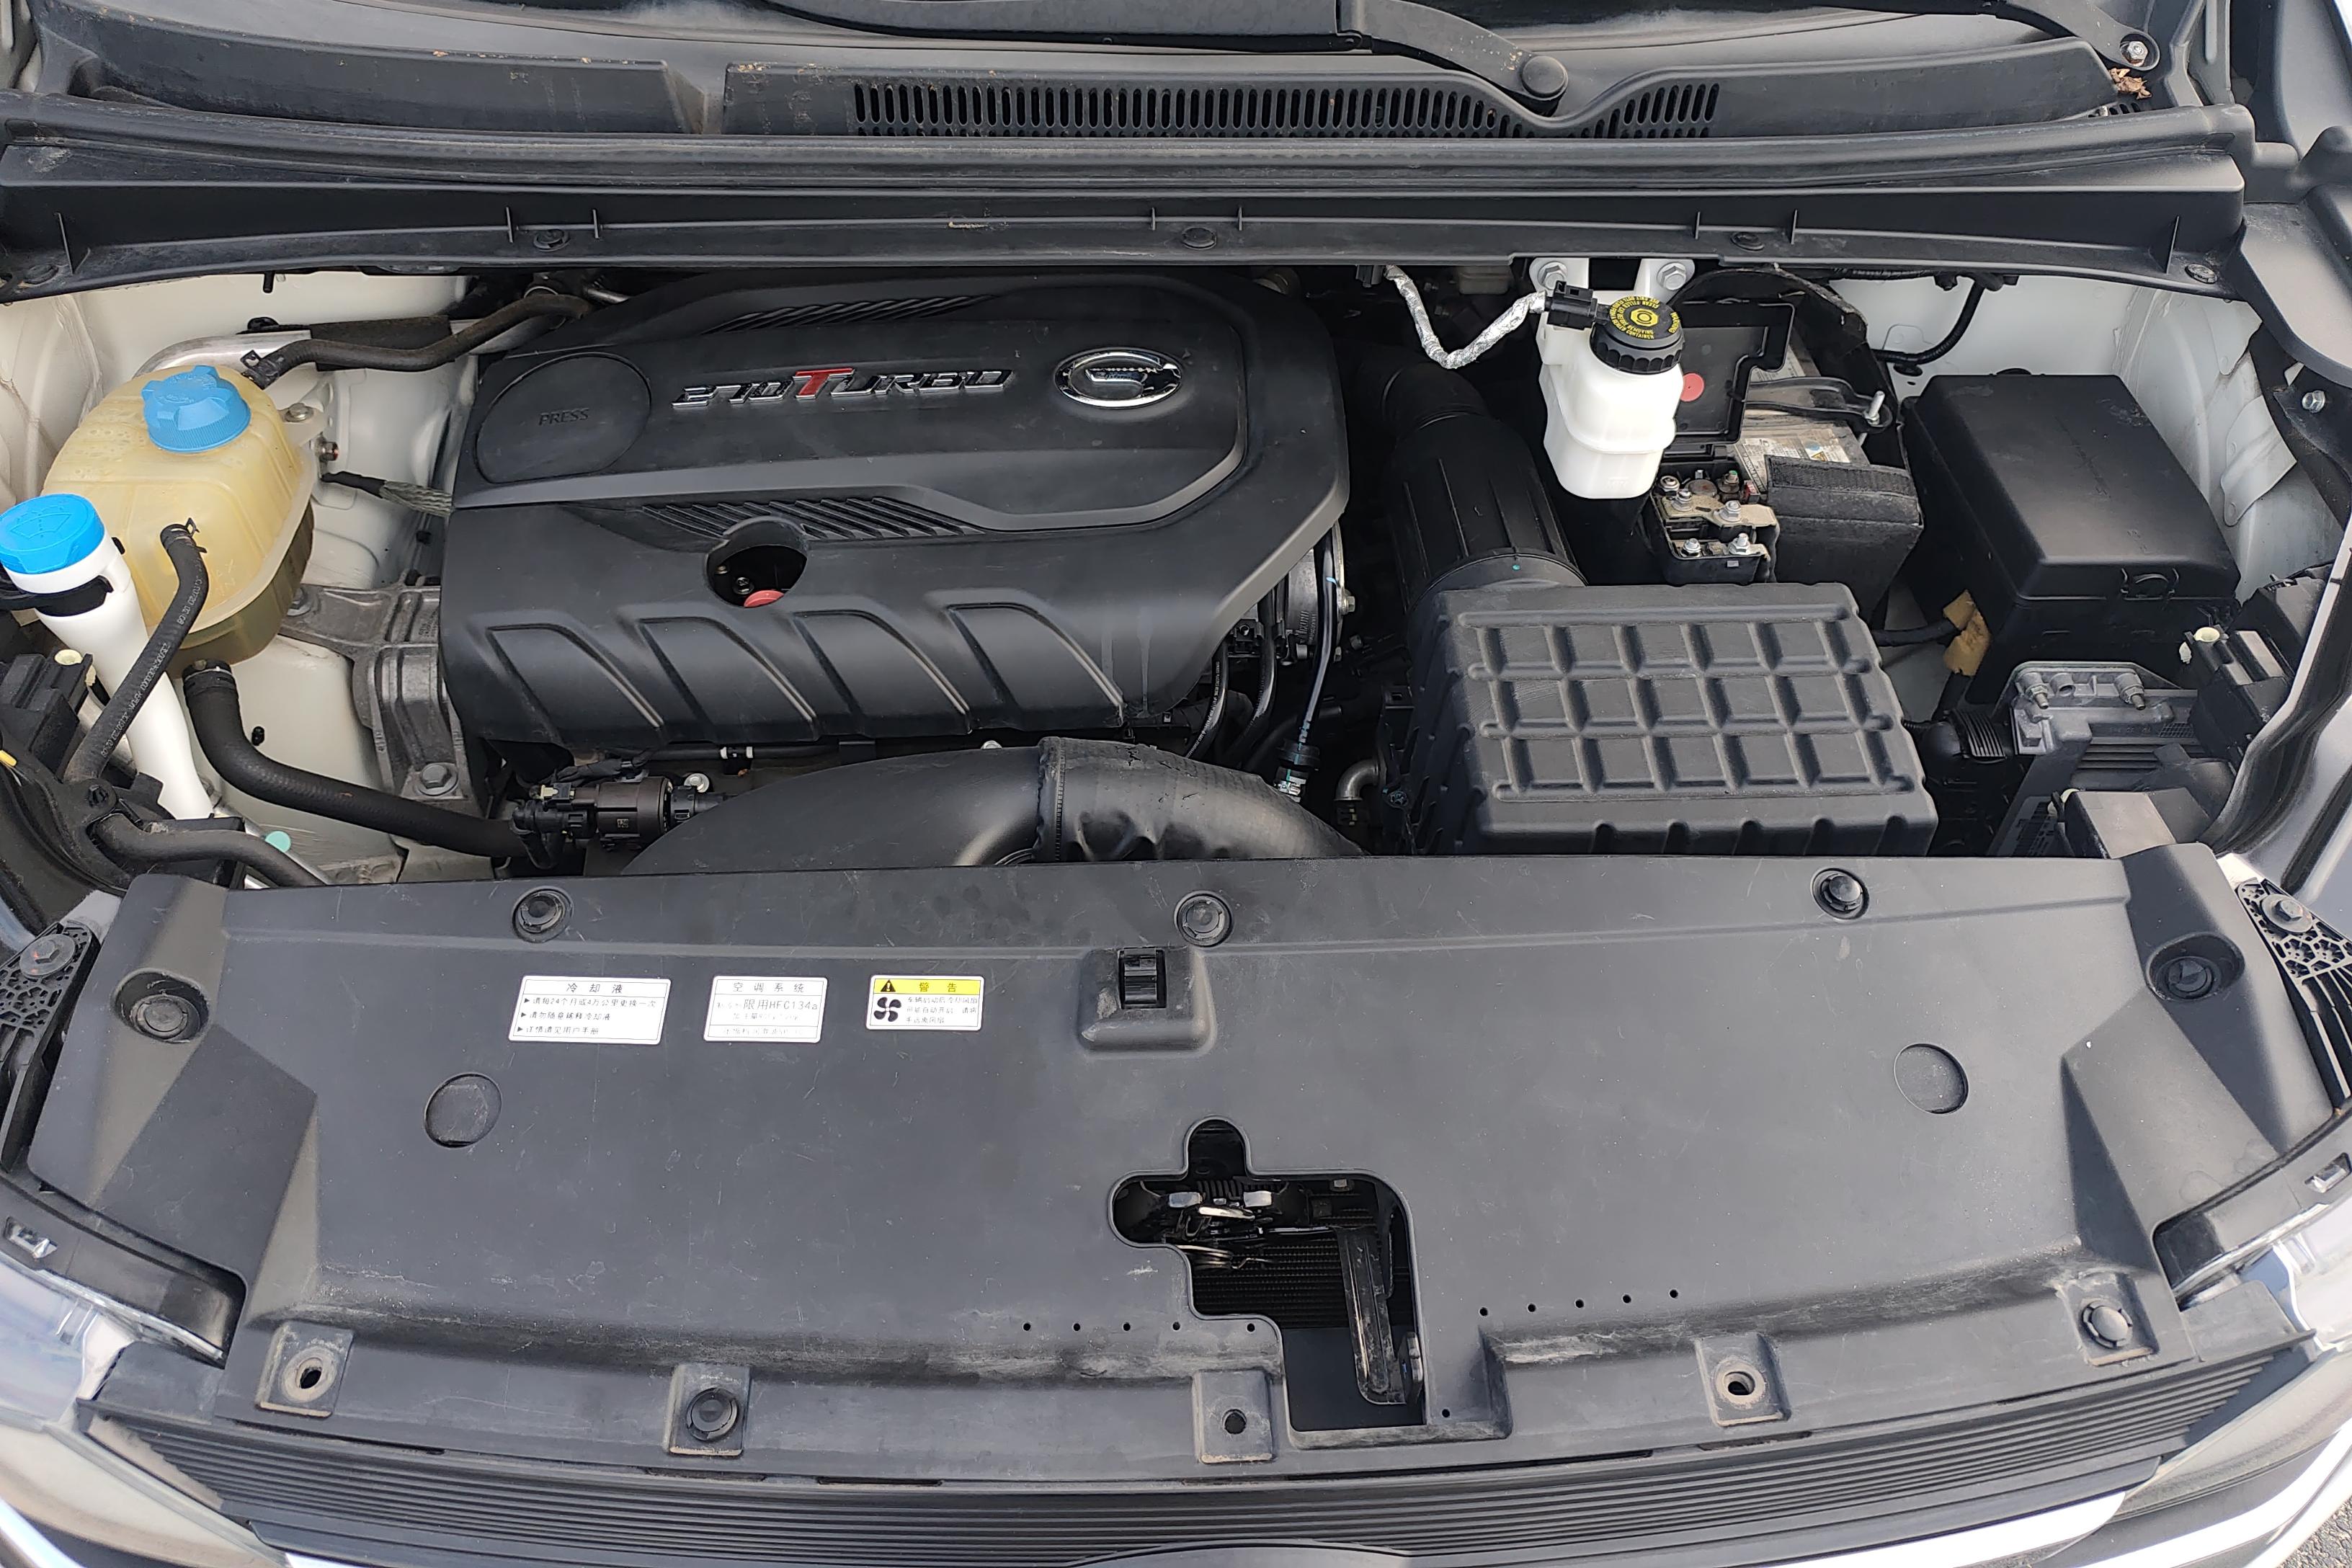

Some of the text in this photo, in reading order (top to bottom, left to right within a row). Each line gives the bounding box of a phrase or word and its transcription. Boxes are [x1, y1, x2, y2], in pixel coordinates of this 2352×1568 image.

[1642, 300, 1660, 309] CLEAN
[1668, 312, 1680, 333] WARNING
[1626, 324, 1654, 335] REMOVING
[1626, 330, 1654, 339] CONTAINER
[538, 408, 589, 426] PRESS
[566, 983, 624, 994] 冷却液
[733, 982, 805, 993] 空调系统
[919, 981, 958, 992] 警告
